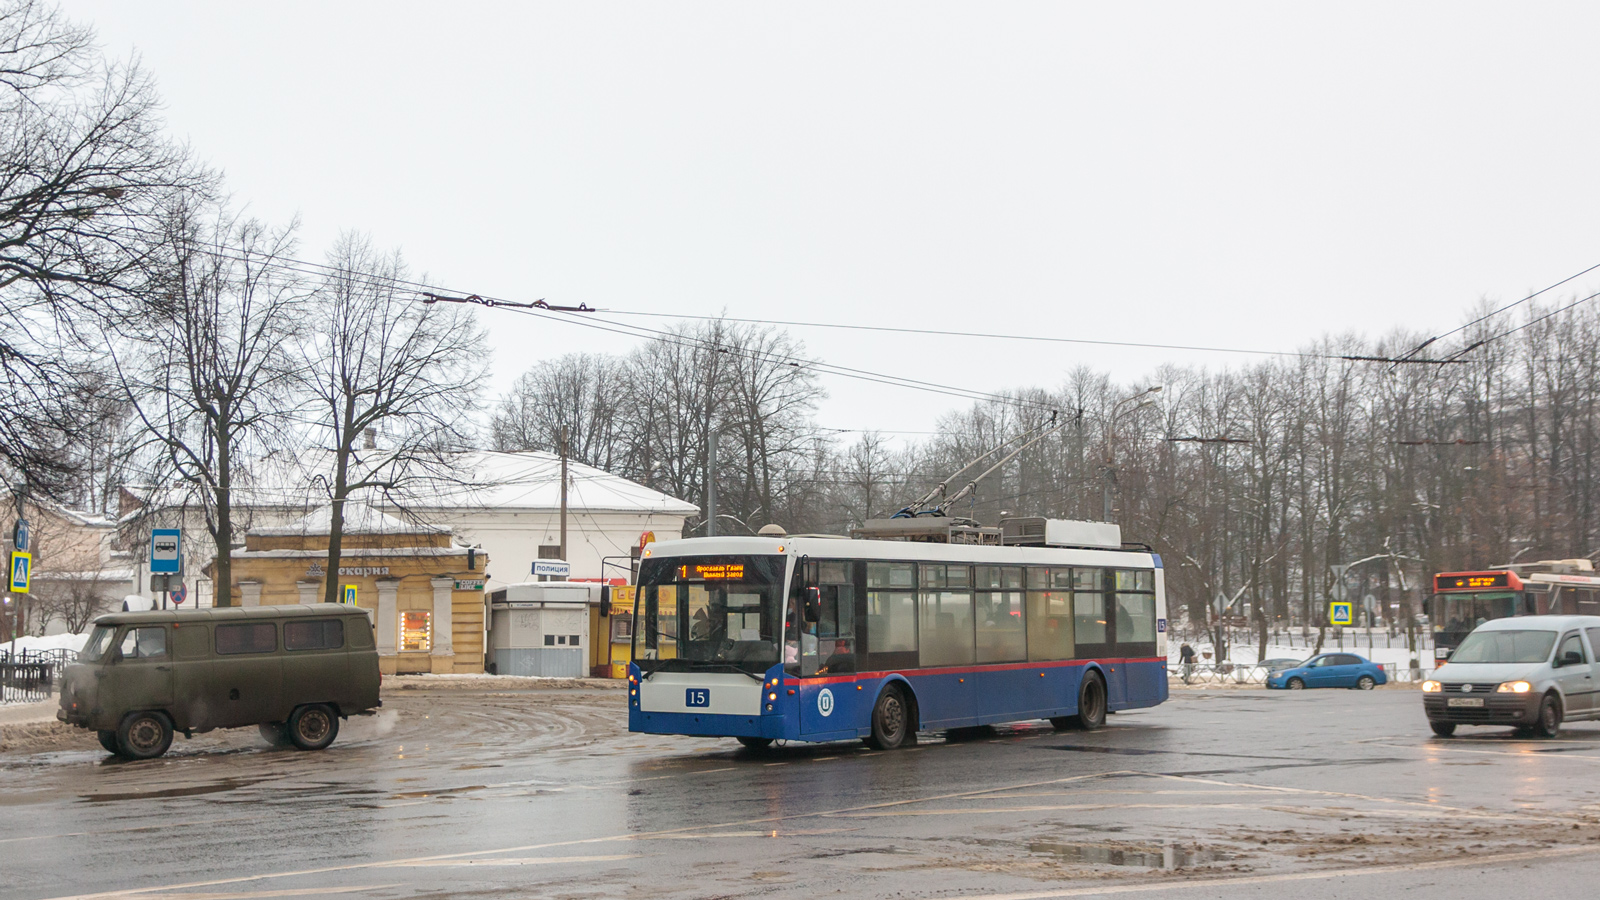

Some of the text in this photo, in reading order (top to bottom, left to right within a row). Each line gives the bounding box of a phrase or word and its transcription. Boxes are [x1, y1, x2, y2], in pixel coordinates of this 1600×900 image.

[337, 566, 389, 578] екарня
[536, 565, 568, 573] ПОЛИЦИЯ
[681, 565, 687, 578] 1
[1158, 620, 1165, 631] 15
[690, 691, 705, 704] 15
